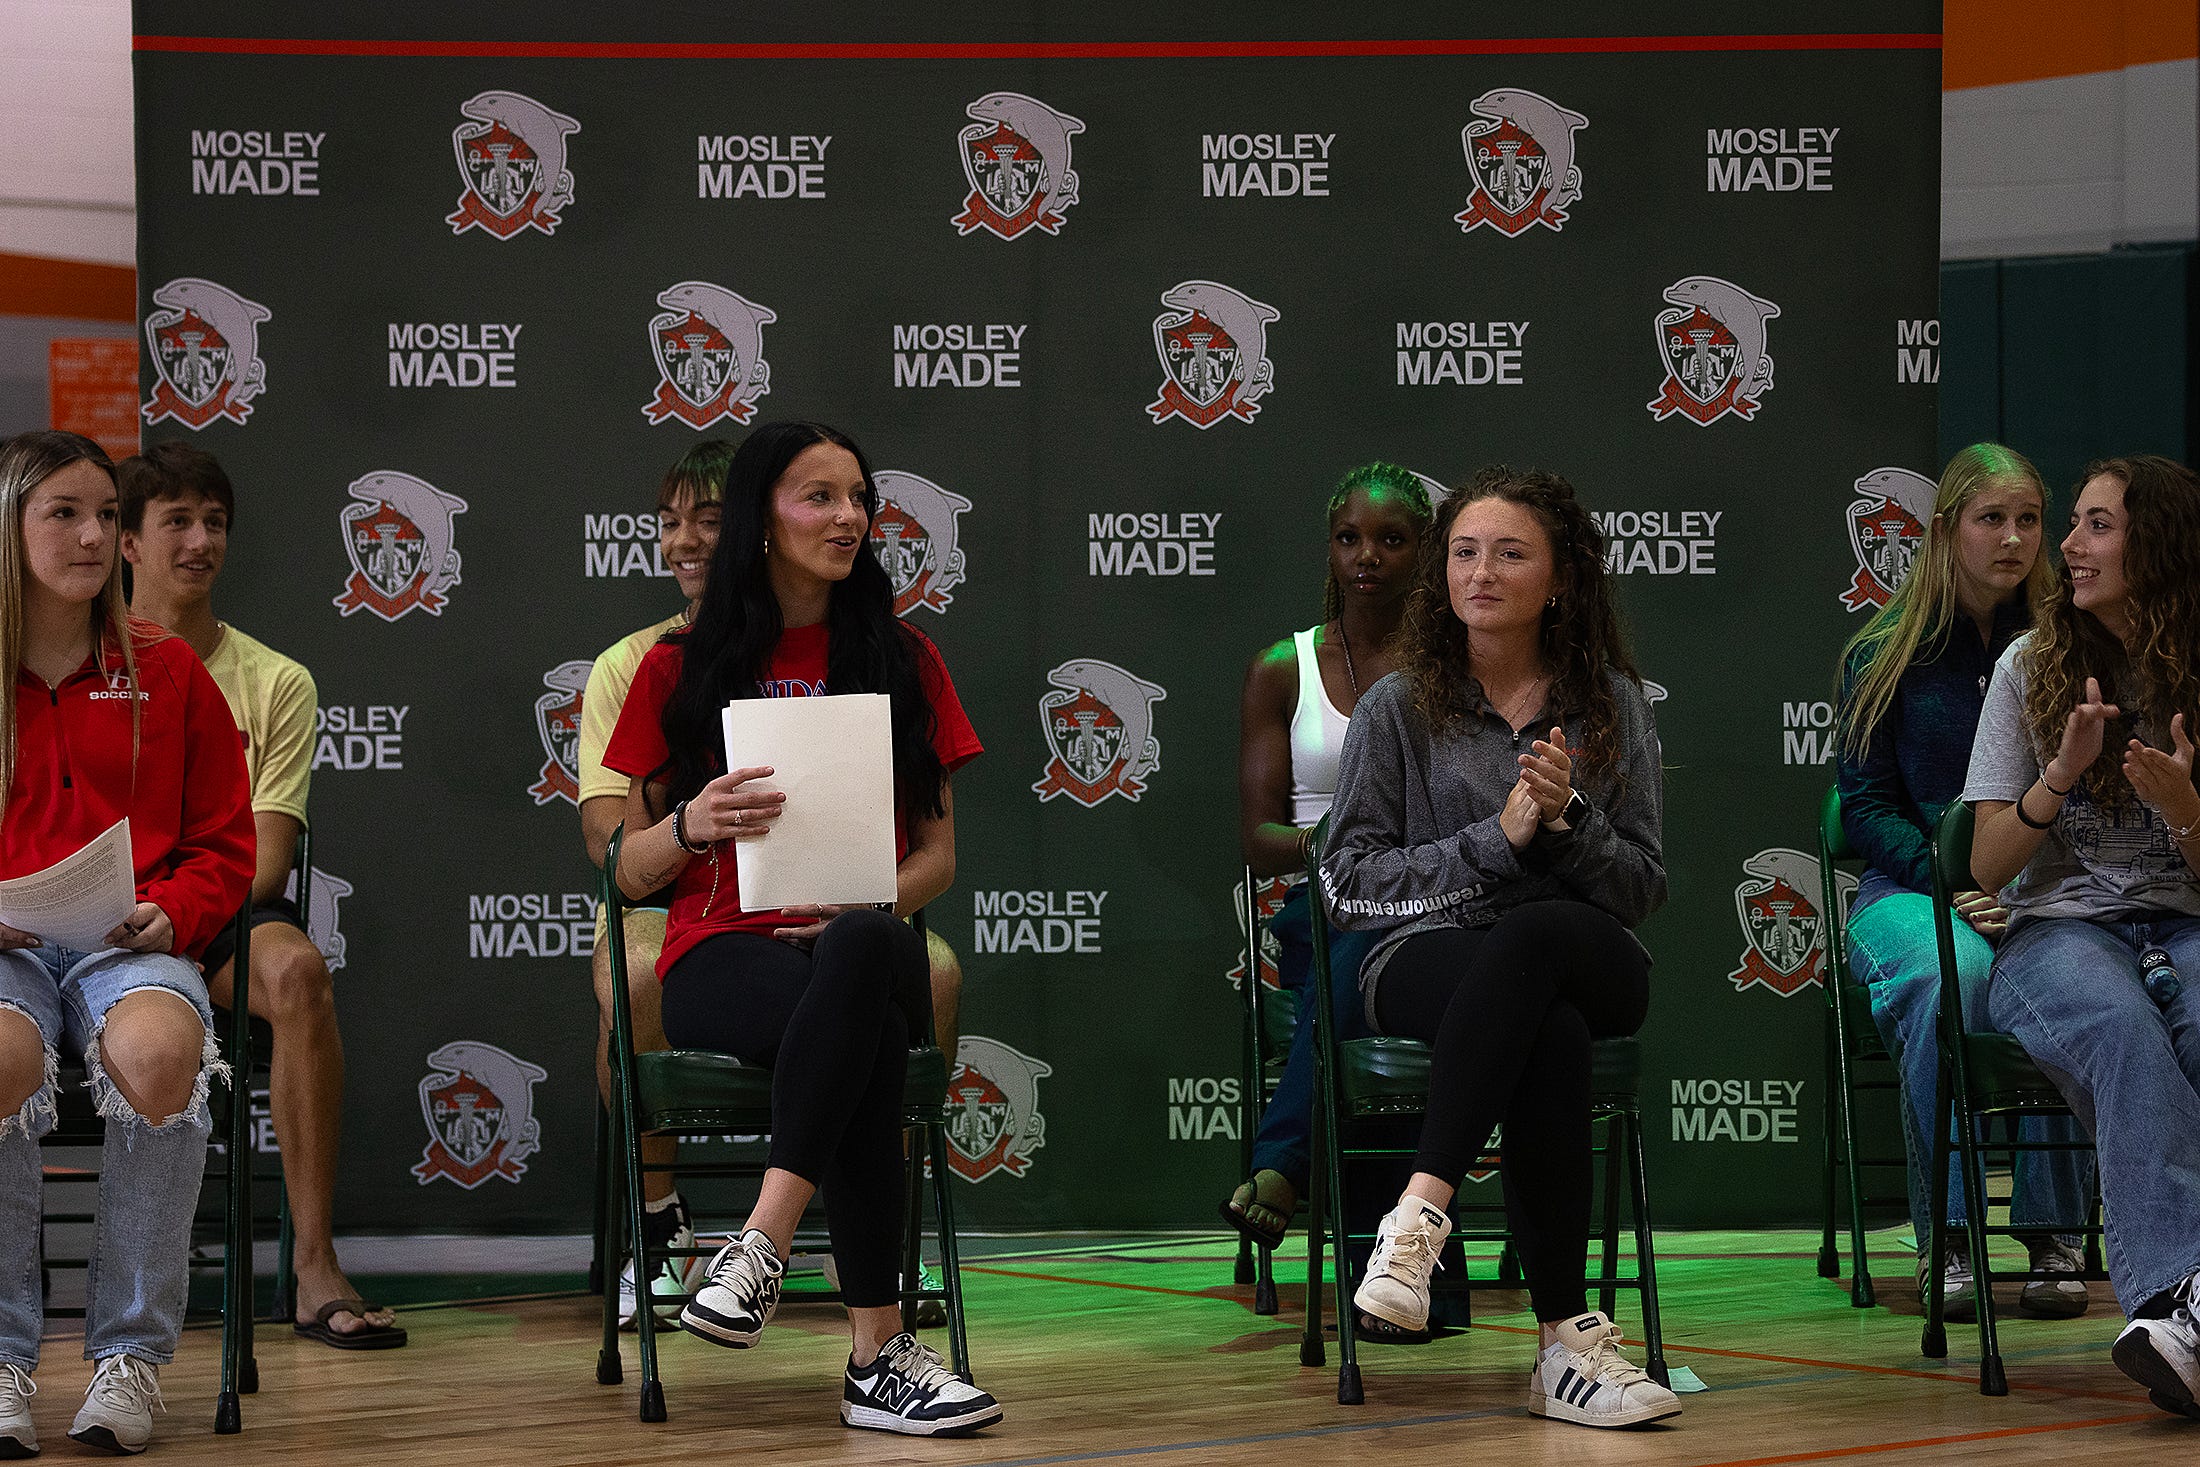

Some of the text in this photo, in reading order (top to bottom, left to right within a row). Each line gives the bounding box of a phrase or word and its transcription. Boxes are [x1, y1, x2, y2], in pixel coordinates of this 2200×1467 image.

[191, 130, 326, 158] MOSLEY
[698, 135, 832, 162] MOSLEY
[1202, 133, 1336, 160] MOSLEY
[1707, 127, 1840, 155] MOSLEY
[192, 159, 320, 196] MADE
[698, 163, 826, 199] MADE
[1202, 161, 1330, 197] MADE
[1707, 156, 1833, 192] MADE
[388, 323, 523, 350] MOSLEY
[893, 324, 1028, 351] MOSLEY
[1396, 321, 1530, 348] MOSLEY
[389, 352, 517, 388] MADE
[894, 352, 1021, 388] MADE
[1396, 350, 1524, 385] MADE
[1088, 512, 1222, 539] MOSLEY
[1591, 511, 1723, 538] MOSLEY
[1089, 541, 1216, 576] MADE
[310, 734, 403, 770] ADE
[469, 893, 599, 921] MOSLEY
[974, 890, 1108, 917] MOSLEY
[469, 922, 596, 958] MADE
[974, 918, 1102, 954] MADE
[1168, 1077, 1243, 1104] MOS
[1671, 1079, 1805, 1106] MOSLEY
[1672, 1107, 1799, 1143] MADE
[1578, 1317, 1598, 1330] adidas
